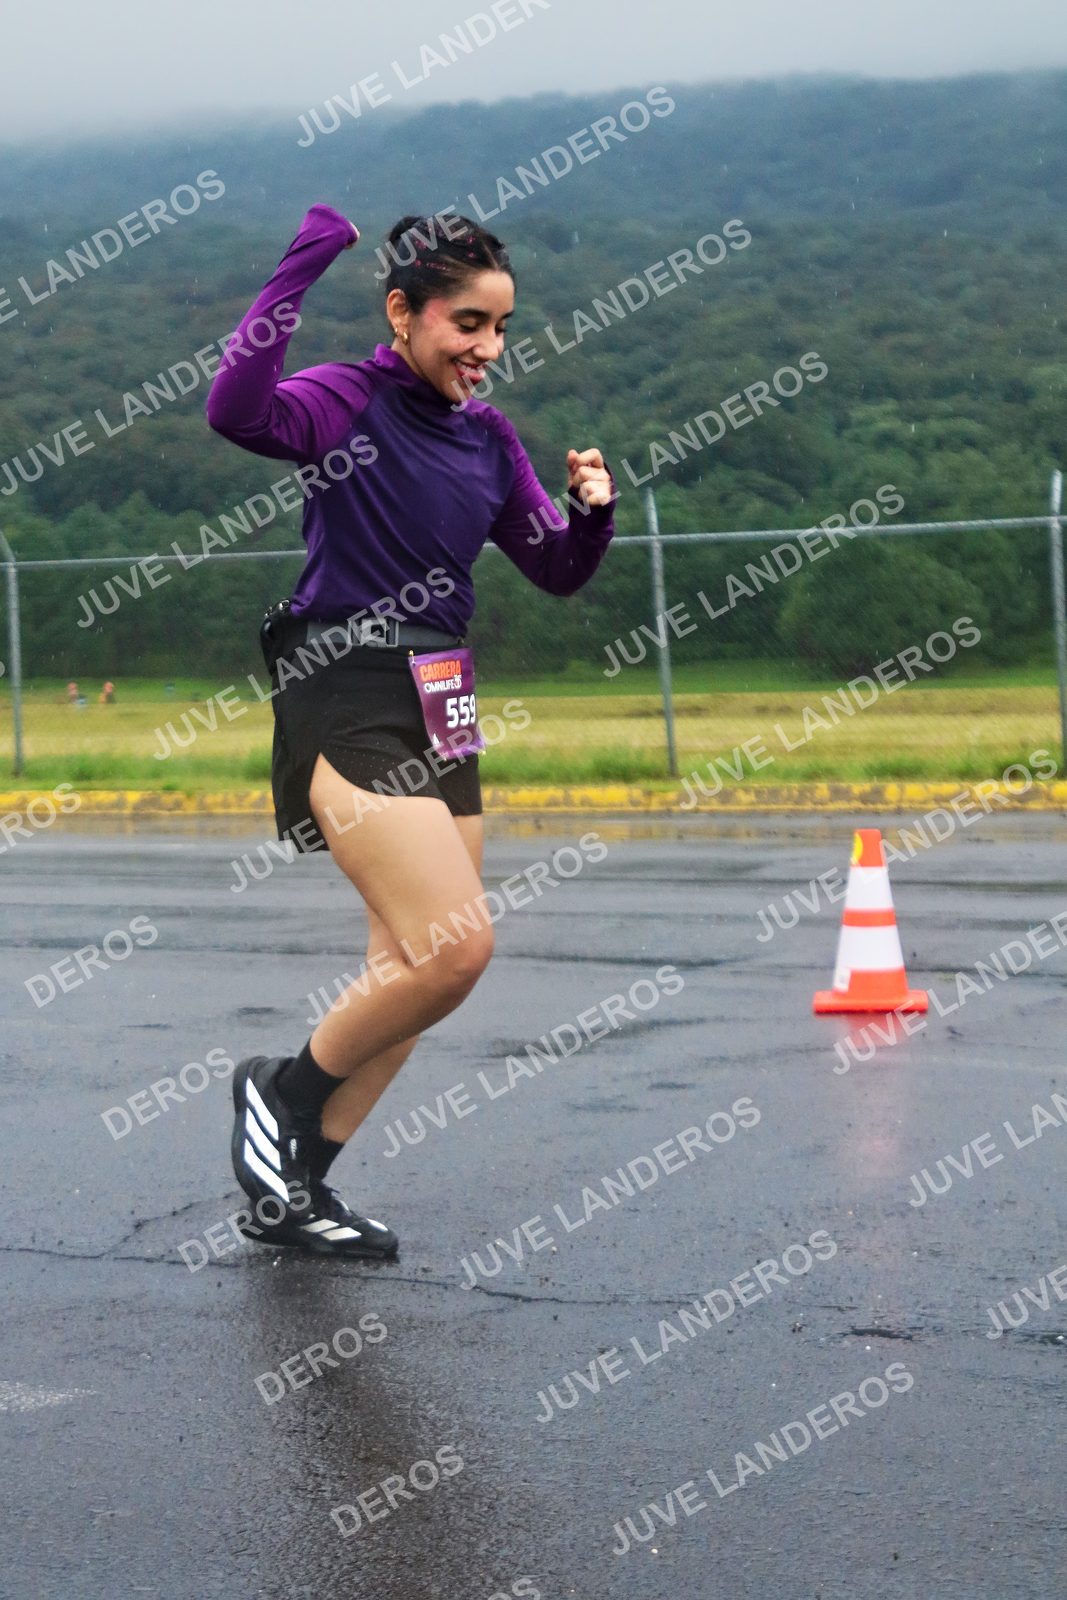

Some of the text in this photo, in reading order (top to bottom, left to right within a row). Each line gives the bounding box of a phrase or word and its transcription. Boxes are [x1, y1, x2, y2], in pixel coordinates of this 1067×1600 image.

[420, 660, 461, 681] CARRERA
[424, 679, 454, 693] OMNILIFE
[446, 694, 475, 728] 559
